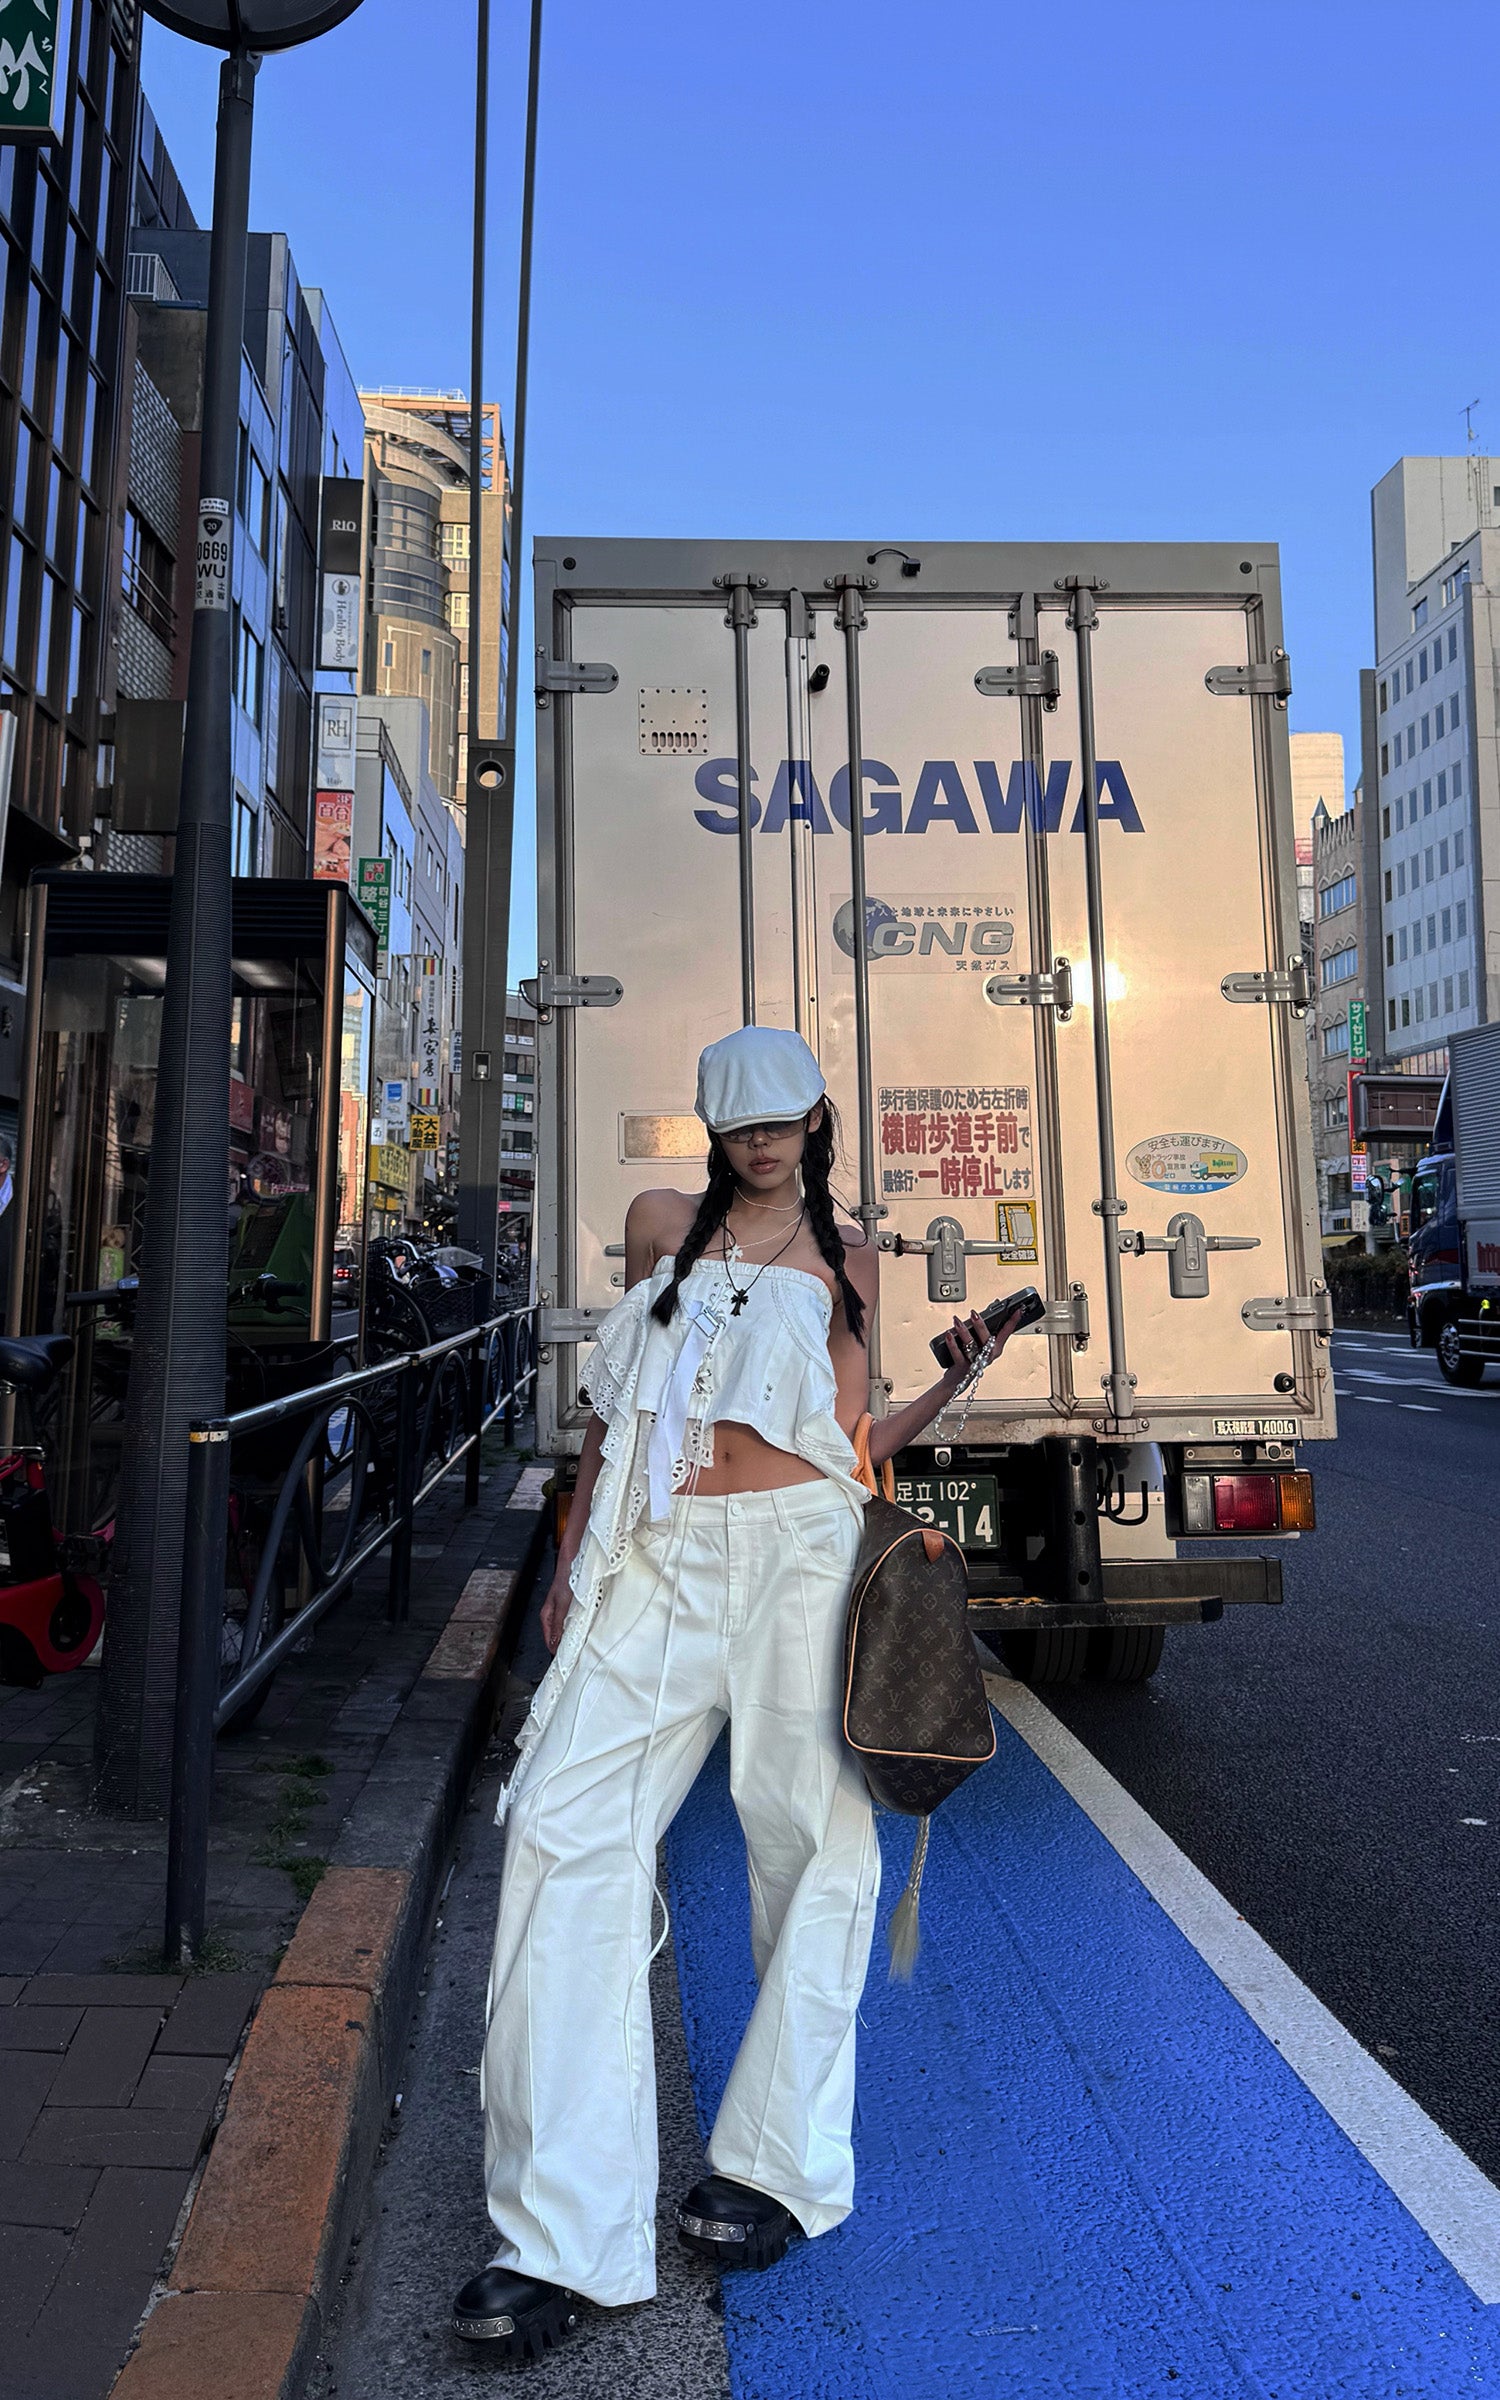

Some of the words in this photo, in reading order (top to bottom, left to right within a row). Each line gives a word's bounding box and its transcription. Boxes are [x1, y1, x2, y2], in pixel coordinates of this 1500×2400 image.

[206, 521, 218, 531] 20
[197, 563, 226, 579] WU
[333, 600, 347, 637] Healthy
[333, 638, 346, 664] Body
[327, 719, 348, 738] RH
[694, 758, 1146, 835] SAGAWA
[377, 886, 389, 946] 四谷三丁目
[878, 905, 1015, 918] 人と地球と未来にやさしい
[872, 921, 1015, 956] CNG
[955, 959, 1011, 972] 天然ガス
[1351, 1002, 1364, 1056] サイゼリヤ
[879, 1088, 1029, 1112] 歩行者保護のため右左折時
[423, 1118, 438, 1144] 大益
[881, 1112, 1031, 1155] 横断歩道手前で
[896, 1481, 935, 1502] 足立
